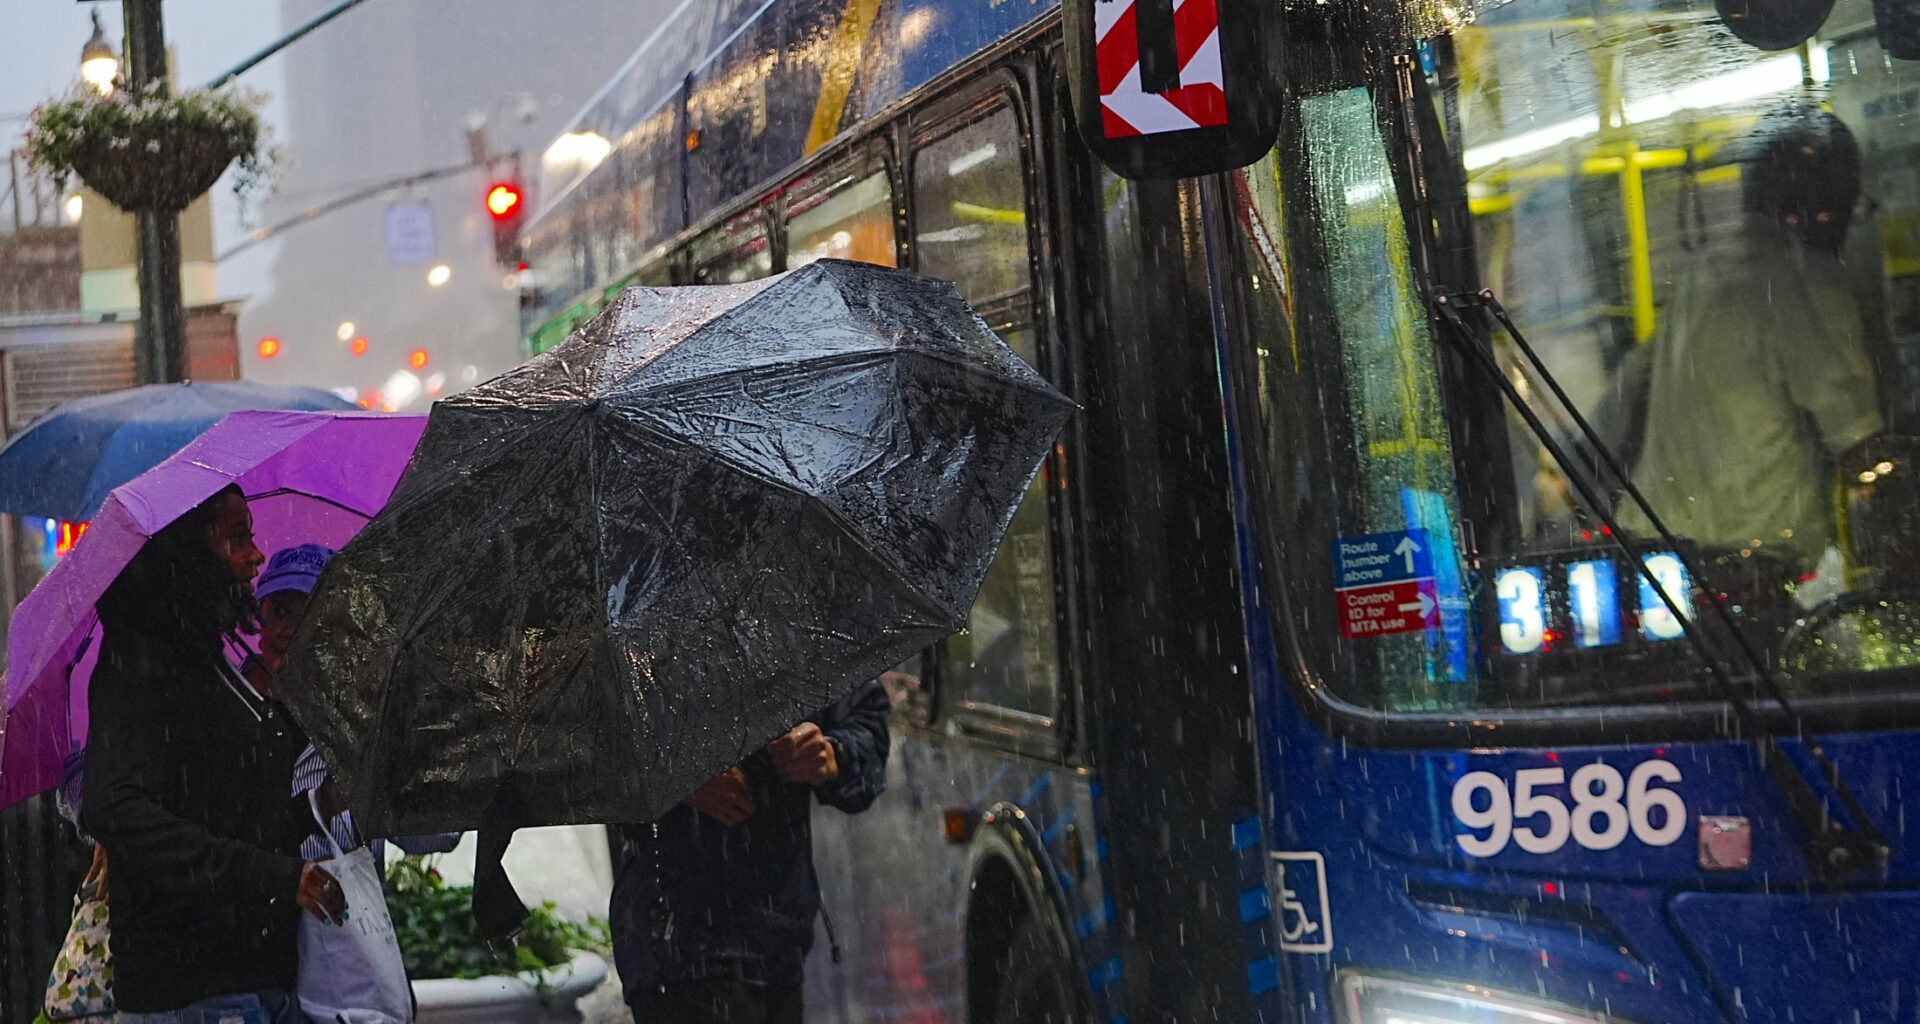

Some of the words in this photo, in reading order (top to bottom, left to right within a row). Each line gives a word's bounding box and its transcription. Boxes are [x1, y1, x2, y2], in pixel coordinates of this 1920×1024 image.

[1341, 541, 1379, 555] Route
[1343, 554, 1391, 569] number
[1343, 569, 1383, 582] above
[1347, 590, 1395, 606] Control
[1348, 607, 1364, 620] ID
[1367, 606, 1386, 618] for
[1350, 619, 1380, 633] MTA
[1381, 618, 1406, 631] use
[1452, 759, 1687, 858] 9586
